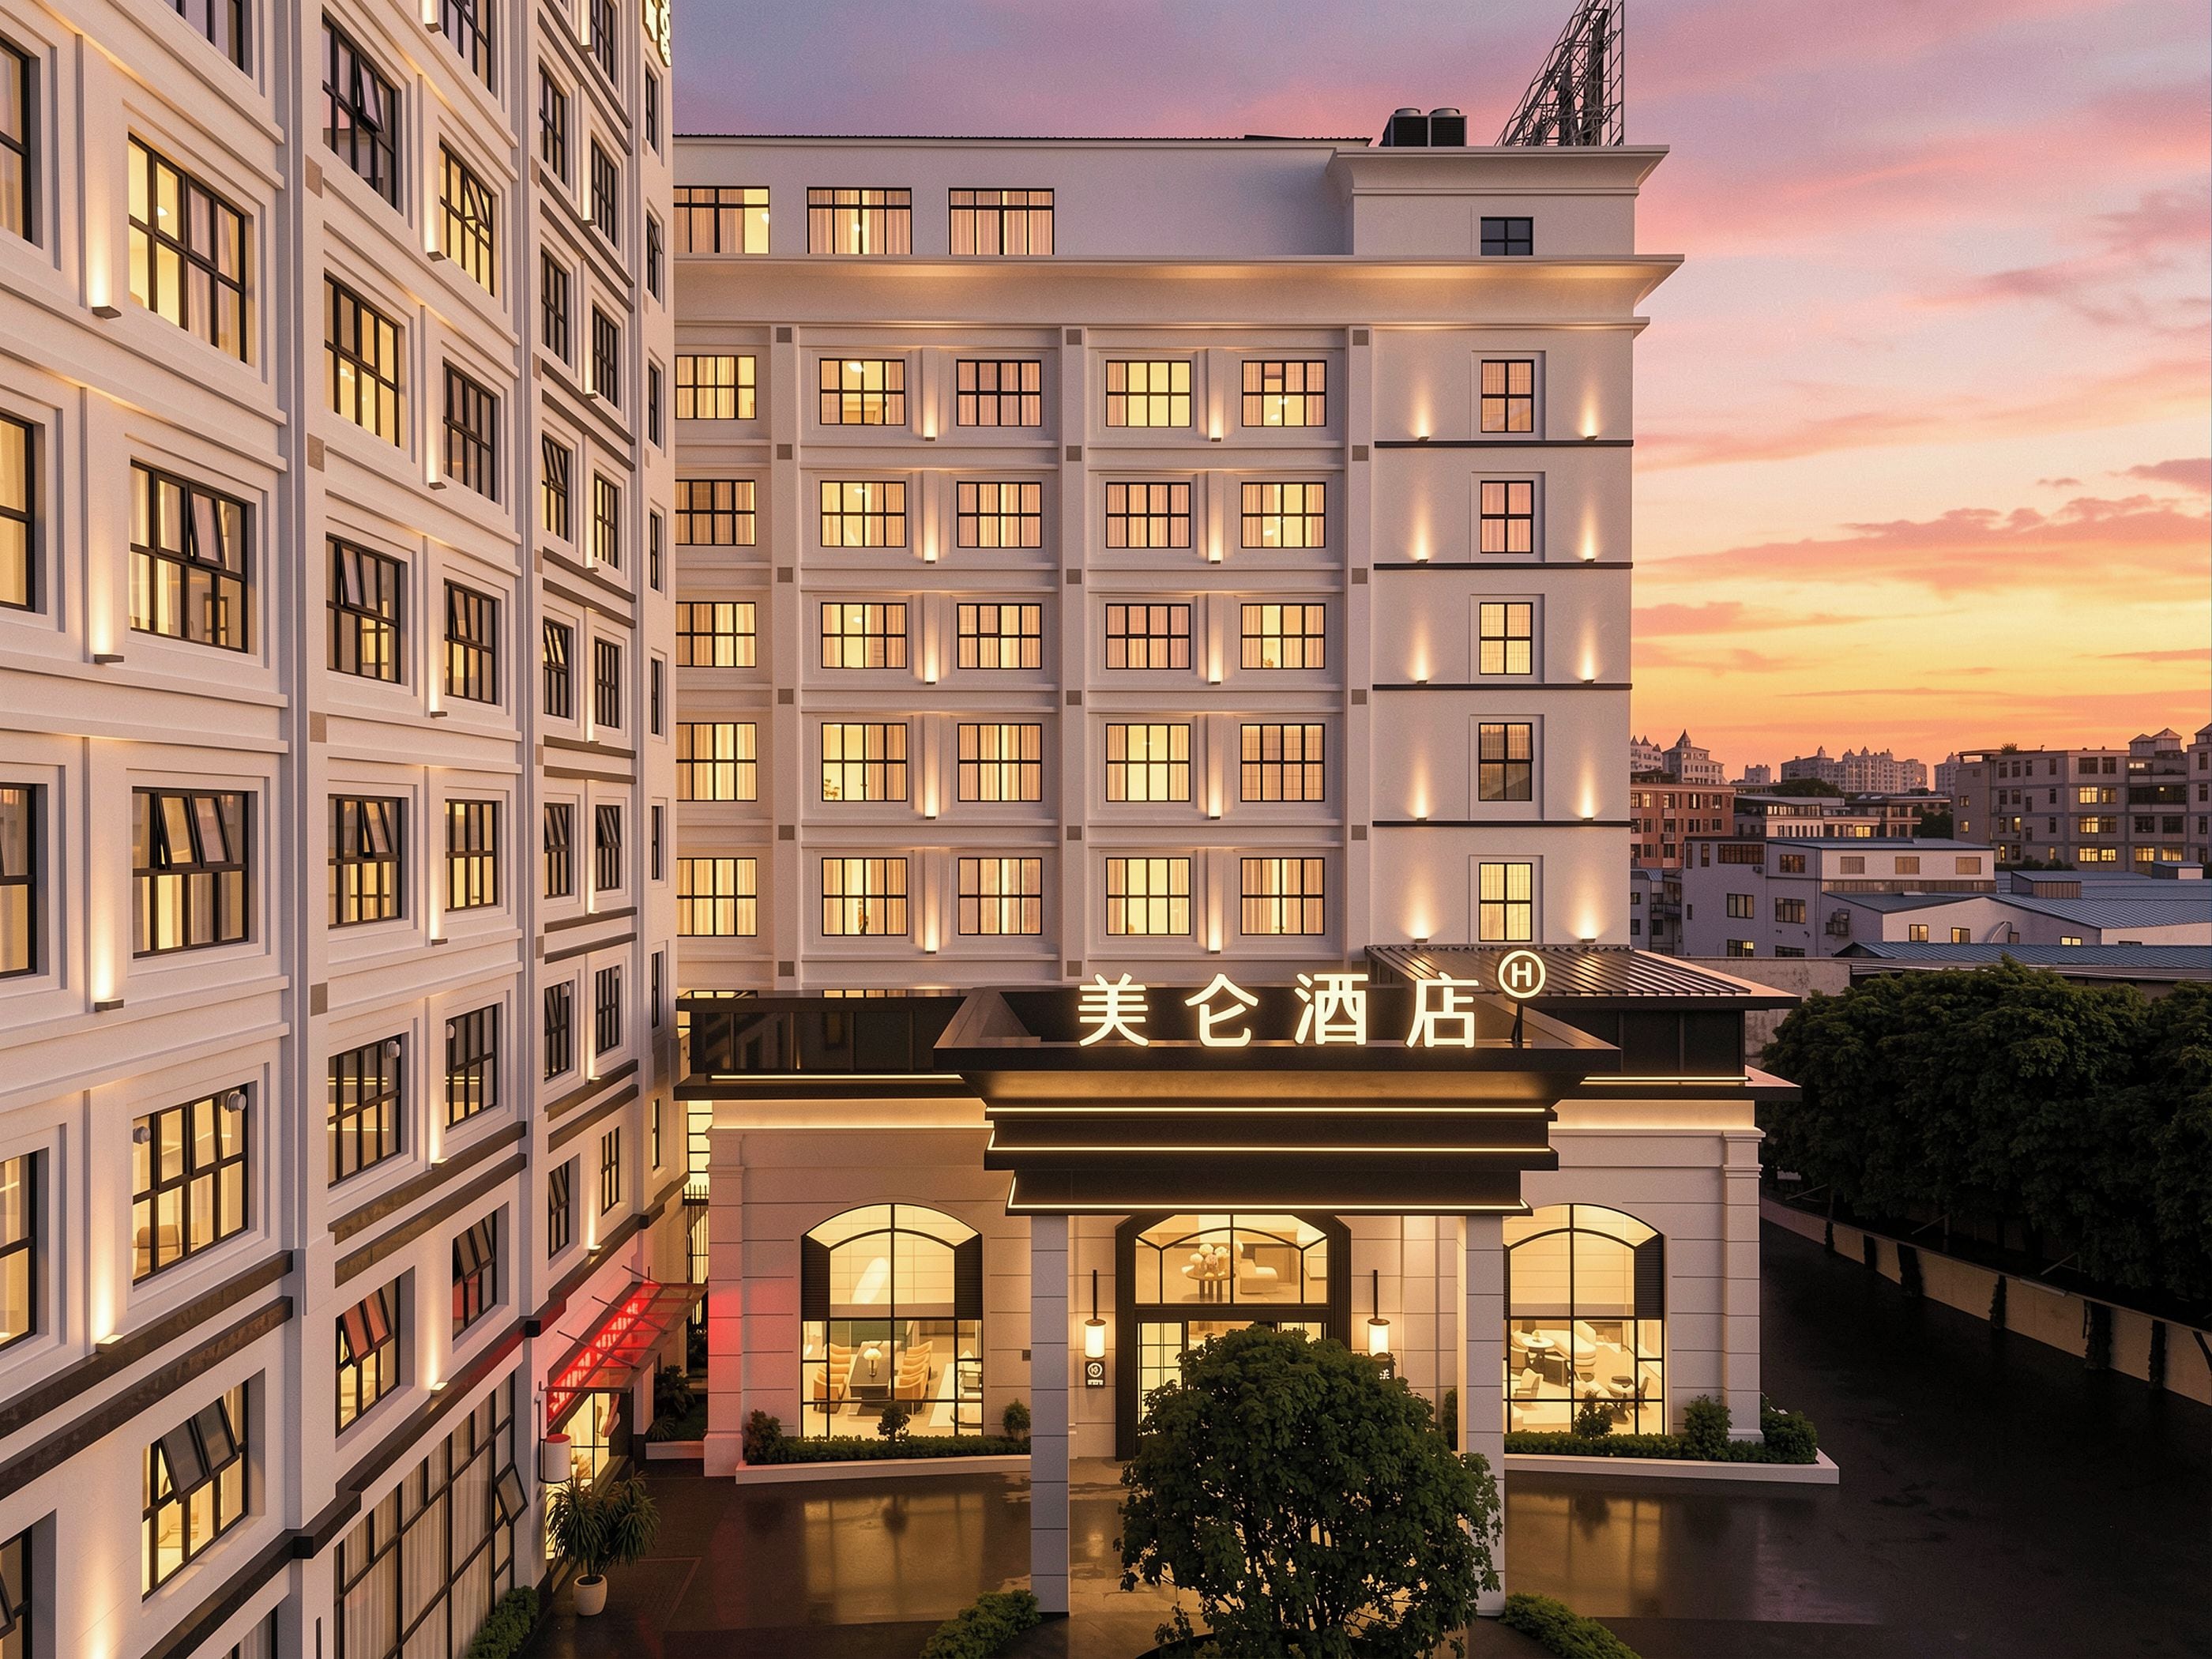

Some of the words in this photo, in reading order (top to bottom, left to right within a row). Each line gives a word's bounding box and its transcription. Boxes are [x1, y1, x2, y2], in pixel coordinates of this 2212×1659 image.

[1511, 961, 1532, 988] H
[1077, 972, 1480, 1048] 美仑酒店
